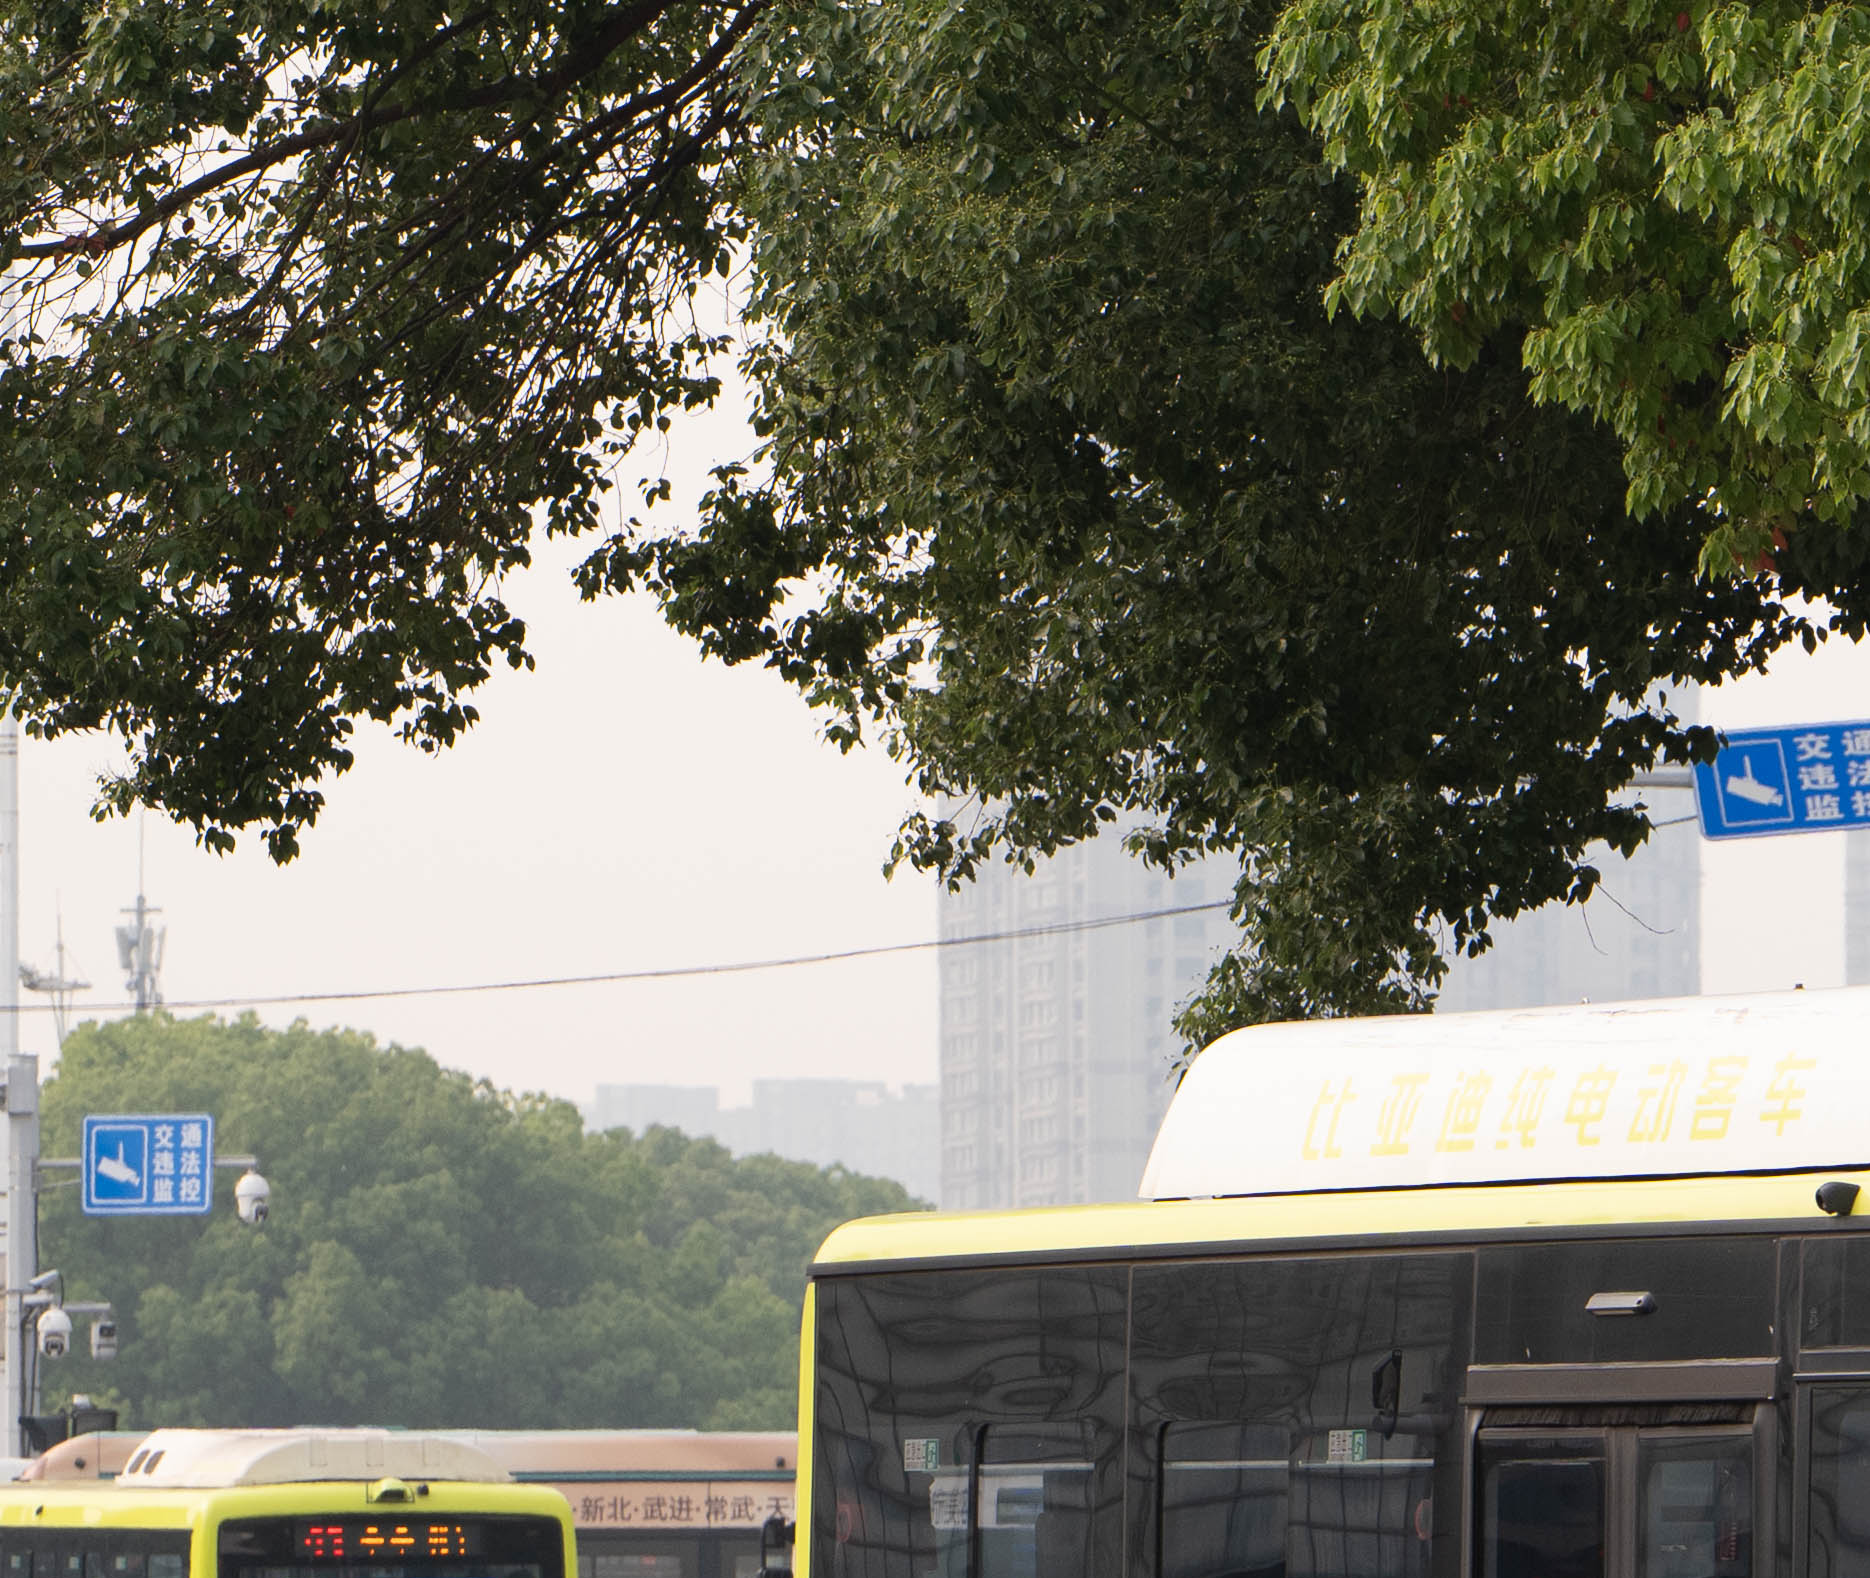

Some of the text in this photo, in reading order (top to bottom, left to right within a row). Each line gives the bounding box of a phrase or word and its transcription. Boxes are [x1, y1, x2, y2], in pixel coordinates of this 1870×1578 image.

[1302, 1052, 1816, 1161] 比亚迪纯电动客车
[154, 1124, 202, 1148] 交通
[153, 1152, 201, 1175] 违法
[153, 1178, 201, 1202] 监控
